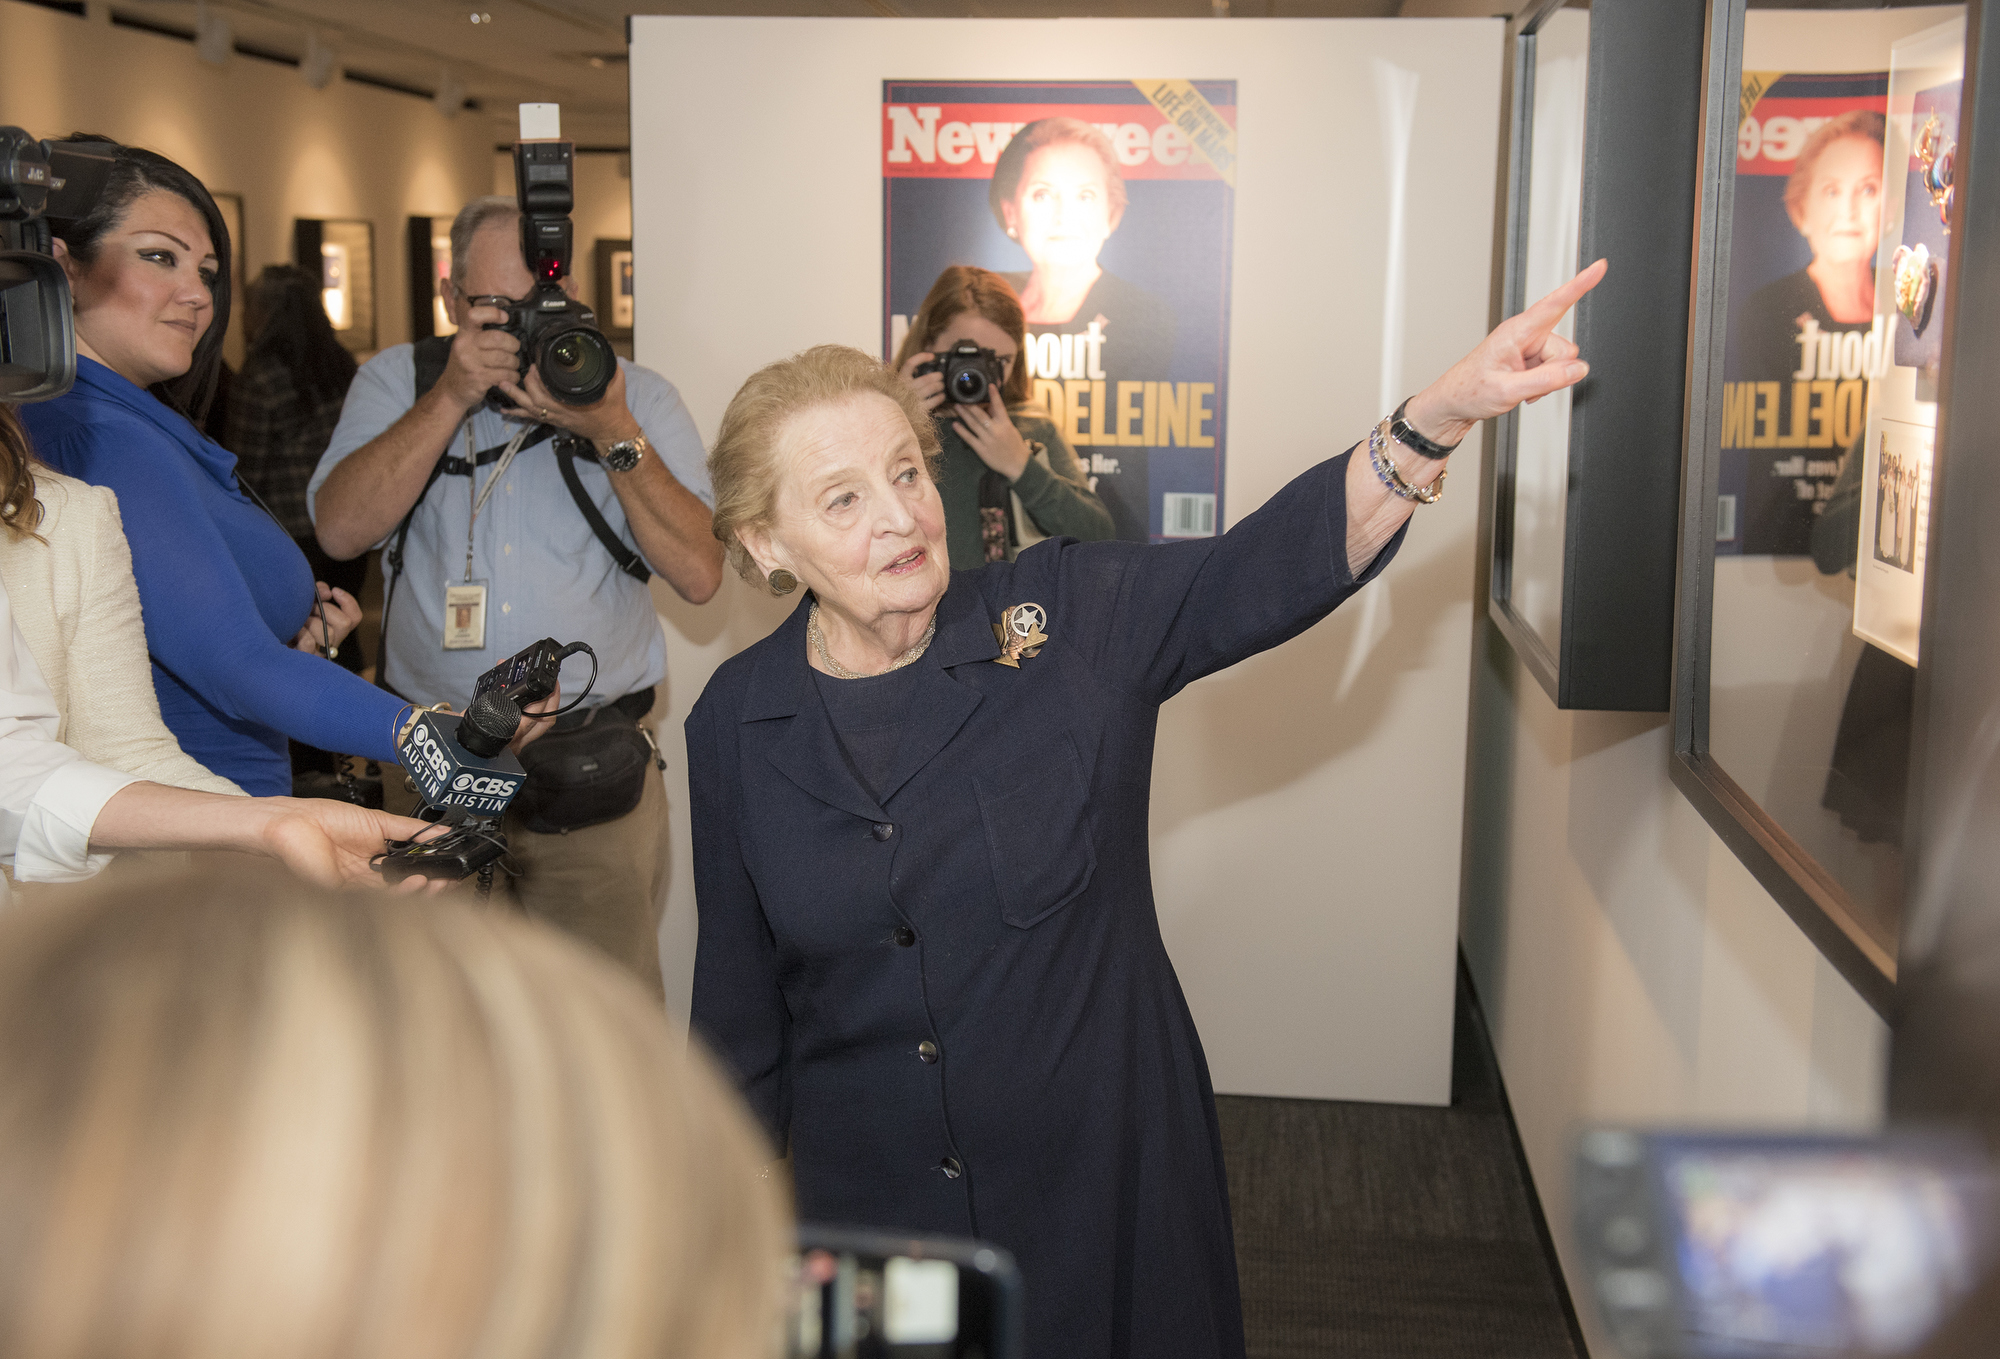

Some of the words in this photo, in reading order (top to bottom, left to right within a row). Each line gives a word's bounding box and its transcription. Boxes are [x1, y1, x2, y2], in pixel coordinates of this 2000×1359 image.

[1151, 83, 1184, 119] LIFE
[1176, 109, 1201, 136] ON
[402, 743, 440, 798] AUSTIN
[422, 738, 451, 782] CBS
[441, 793, 507, 811] AUSTIN
[471, 778, 518, 797] CBS
